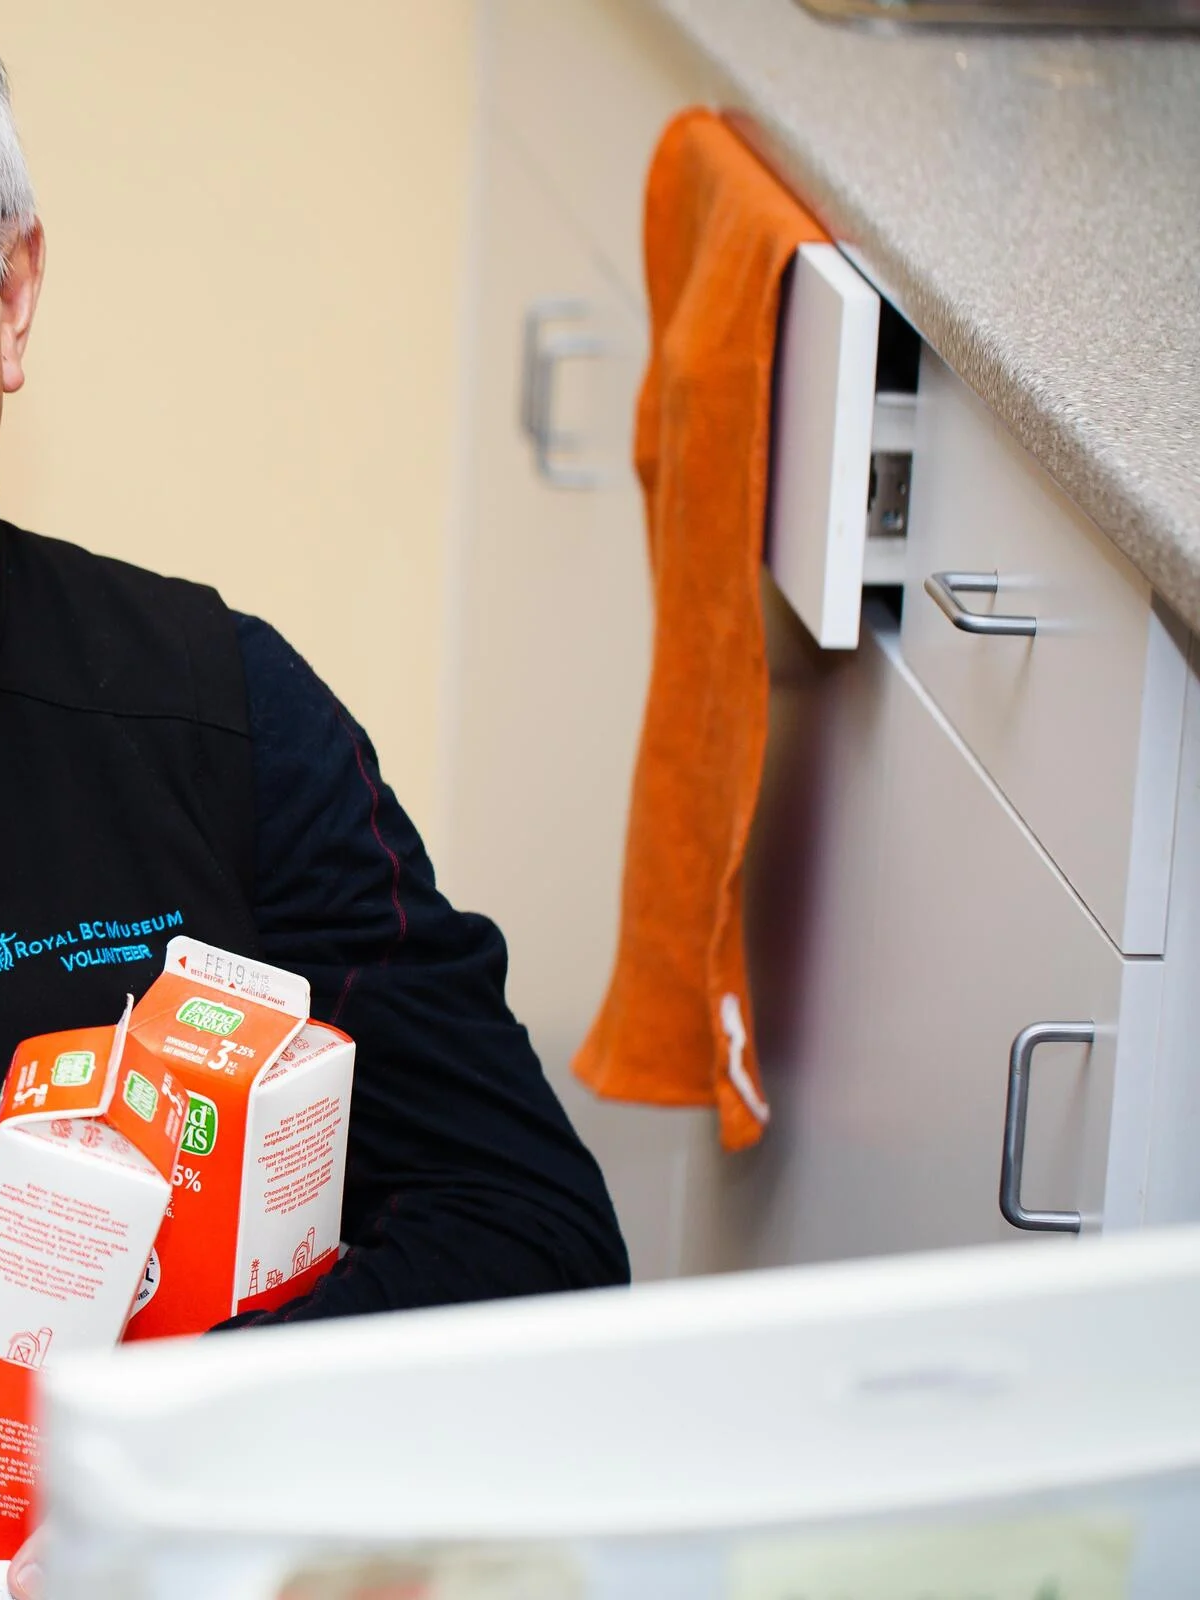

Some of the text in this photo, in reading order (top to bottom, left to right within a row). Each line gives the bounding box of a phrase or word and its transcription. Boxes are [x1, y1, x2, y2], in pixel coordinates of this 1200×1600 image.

[14, 910, 184, 958] ROYAL BC MUSEUM
[60, 943, 152, 972] VOLUNTEER
[204, 952, 245, 986] FE19
[190, 969, 203, 978] BEST
[204, 973, 225, 985] BEFORE
[241, 985, 267, 1001] MEILLEUR
[267, 994, 286, 1007] AVANT
[181, 1010, 231, 1034] FARMS
[264, 1131, 279, 1140] every
[281, 1124, 290, 1133] day
[306, 1104, 324, 1120] product
[280, 1115, 294, 1127] Enjoy
[295, 1107, 307, 1119] local
[296, 1121, 312, 1133] energy
[314, 1116, 322, 1125] and
[257, 1150, 284, 1163] Choosing
[302, 1134, 315, 1146] Farms
[322, 1124, 332, 1133] more
[266, 1139, 320, 1169] just choosing brand
[284, 1143, 325, 1169] choosing make
[263, 1184, 289, 1198] Choosing
[307, 1167, 320, 1180] Farms
[267, 1156, 318, 1183] commitment your
[265, 1190, 307, 1213] cooperative that
[267, 1190, 291, 1205] choosing
[293, 1184, 303, 1194] milk
[305, 1175, 316, 1188] from
[288, 1202, 296, 1212] our
[5, 1426, 16, 1435] de
[0, 1442, 21, 1452] gens
[10, 1458, 30, 1470] bien
[2, 1495, 32, 1507] choisir
